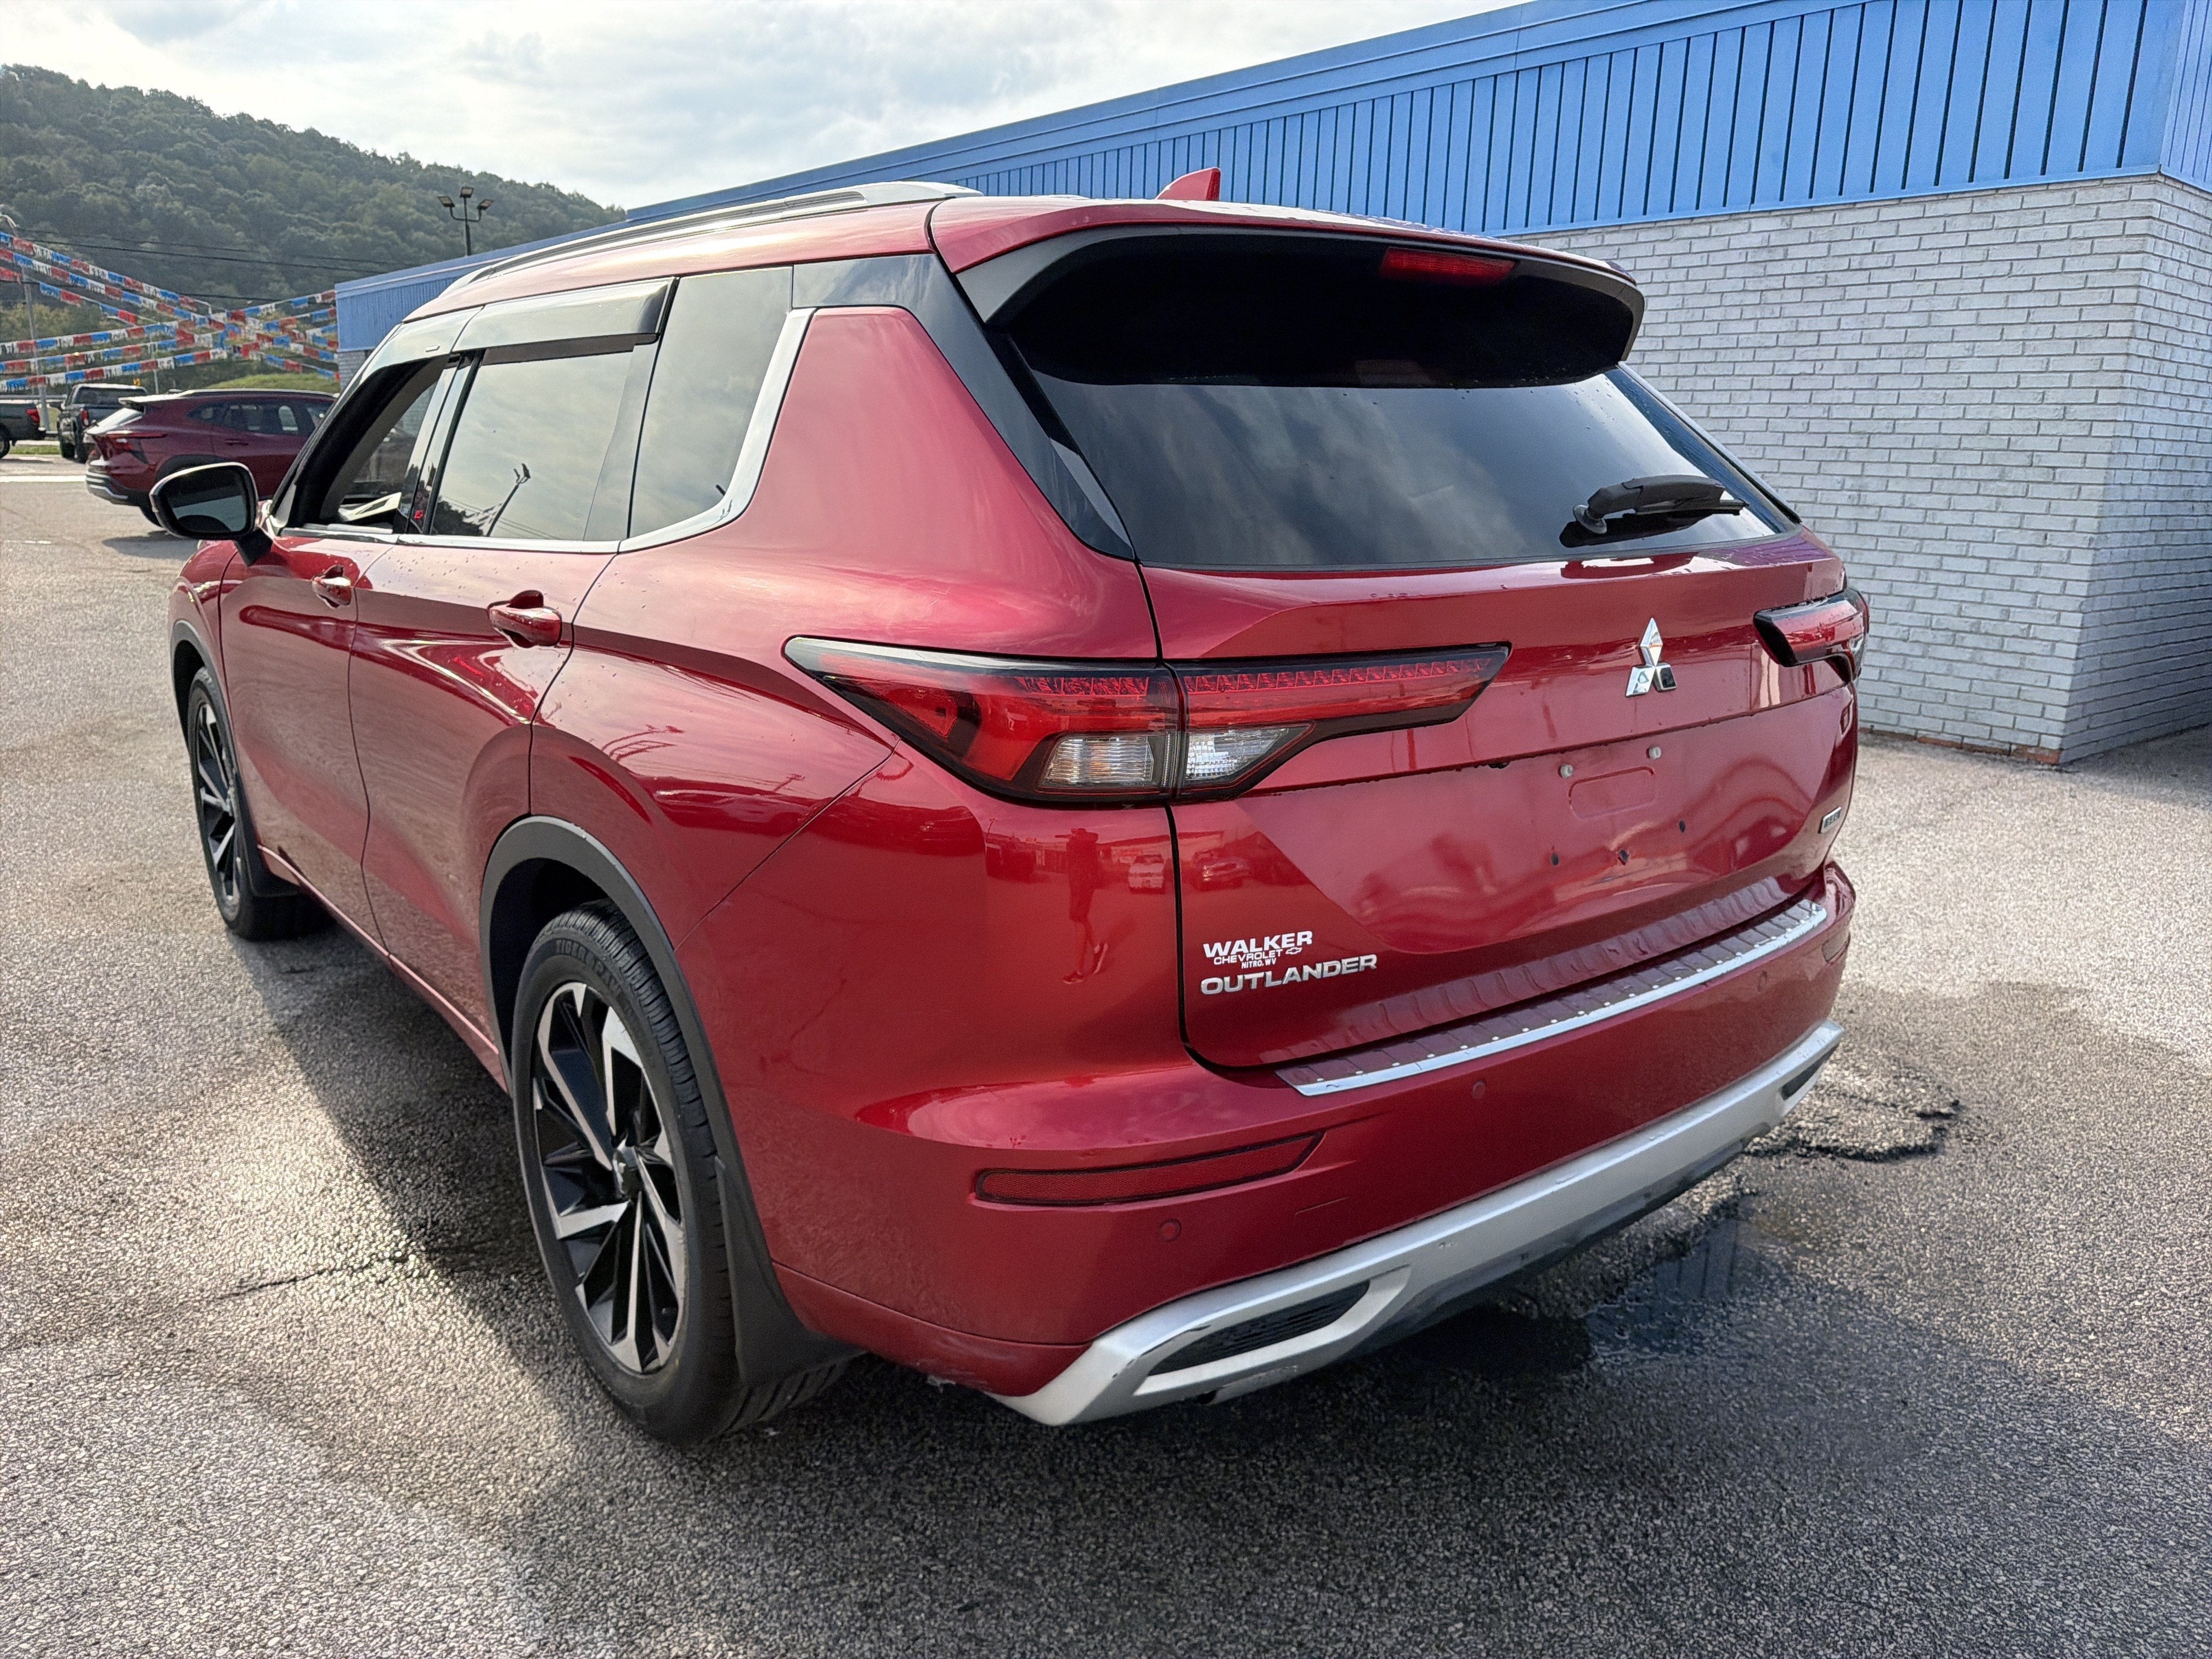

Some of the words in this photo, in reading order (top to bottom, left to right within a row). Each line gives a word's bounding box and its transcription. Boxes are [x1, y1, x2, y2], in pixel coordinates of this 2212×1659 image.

[1203, 930, 1313, 958] WALKER
[1214, 949, 1283, 965] CHEVROLET
[1265, 957, 1277, 966] WV
[1200, 954, 1378, 995] OUTLANDER
